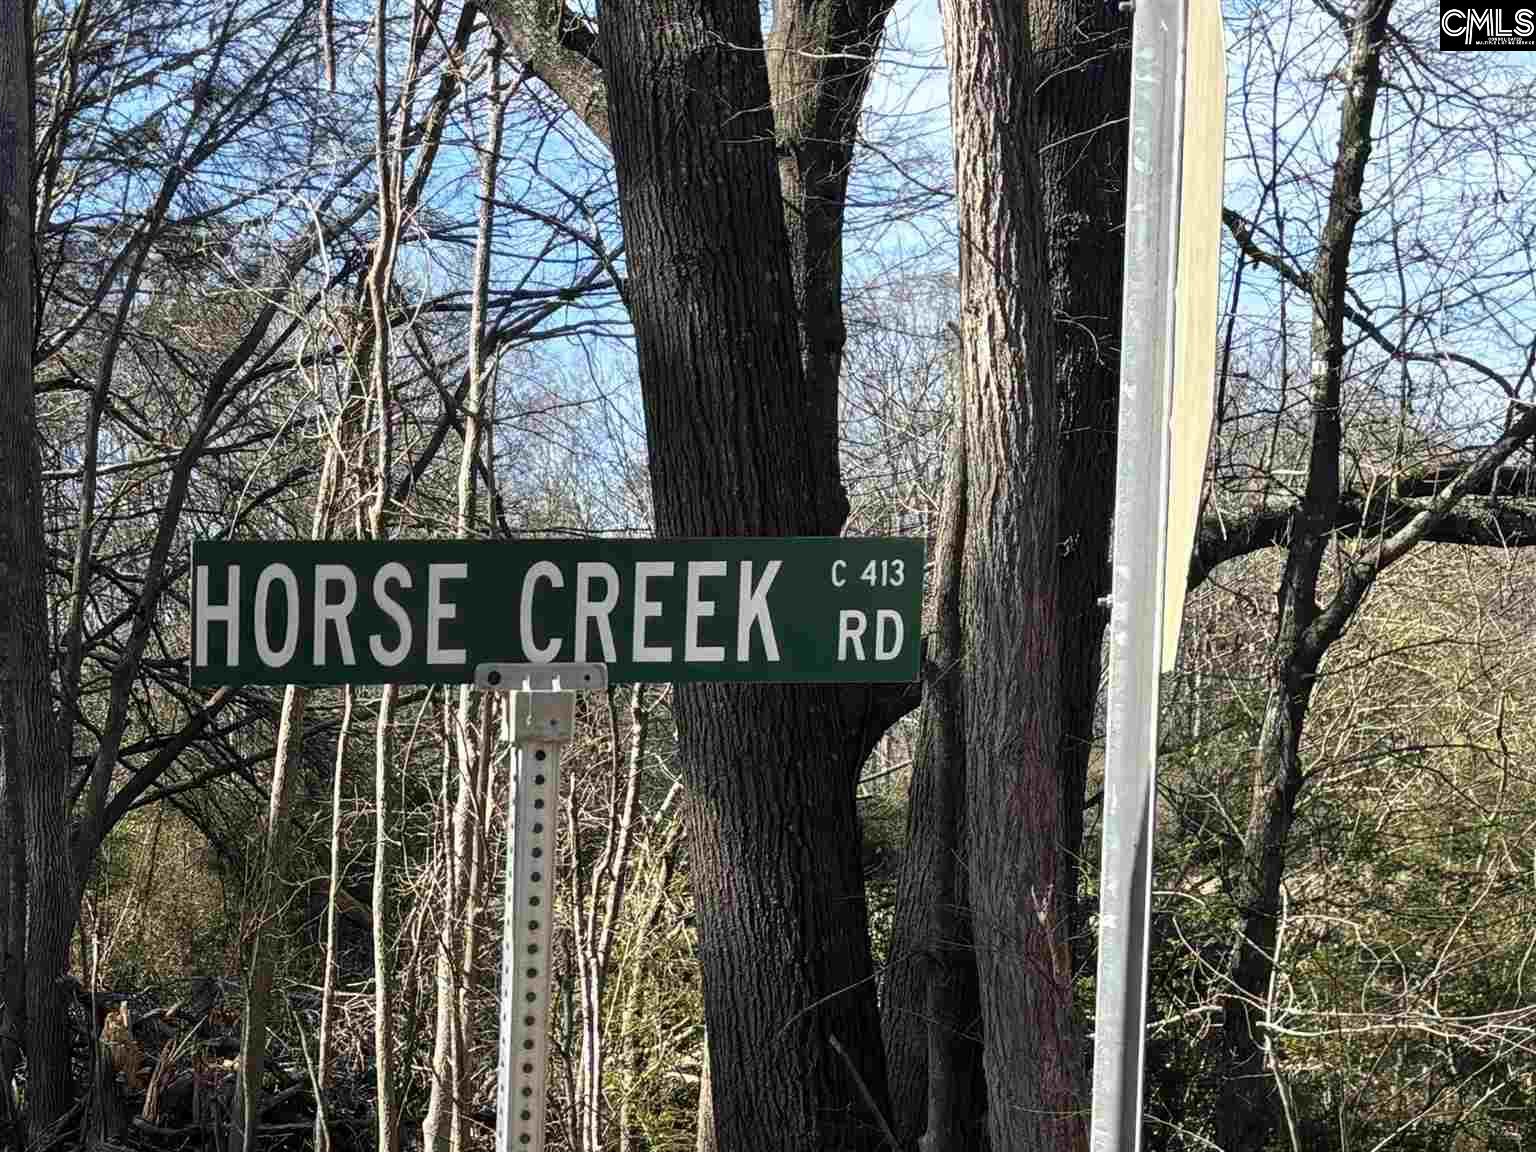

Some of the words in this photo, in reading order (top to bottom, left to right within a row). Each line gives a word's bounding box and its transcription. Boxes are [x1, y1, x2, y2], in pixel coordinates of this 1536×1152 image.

[832, 560, 846, 587] C
[861, 559, 905, 587] 413
[197, 562, 467, 667] HORSE
[519, 560, 781, 664] CREEK
[838, 610, 905, 662] RD
